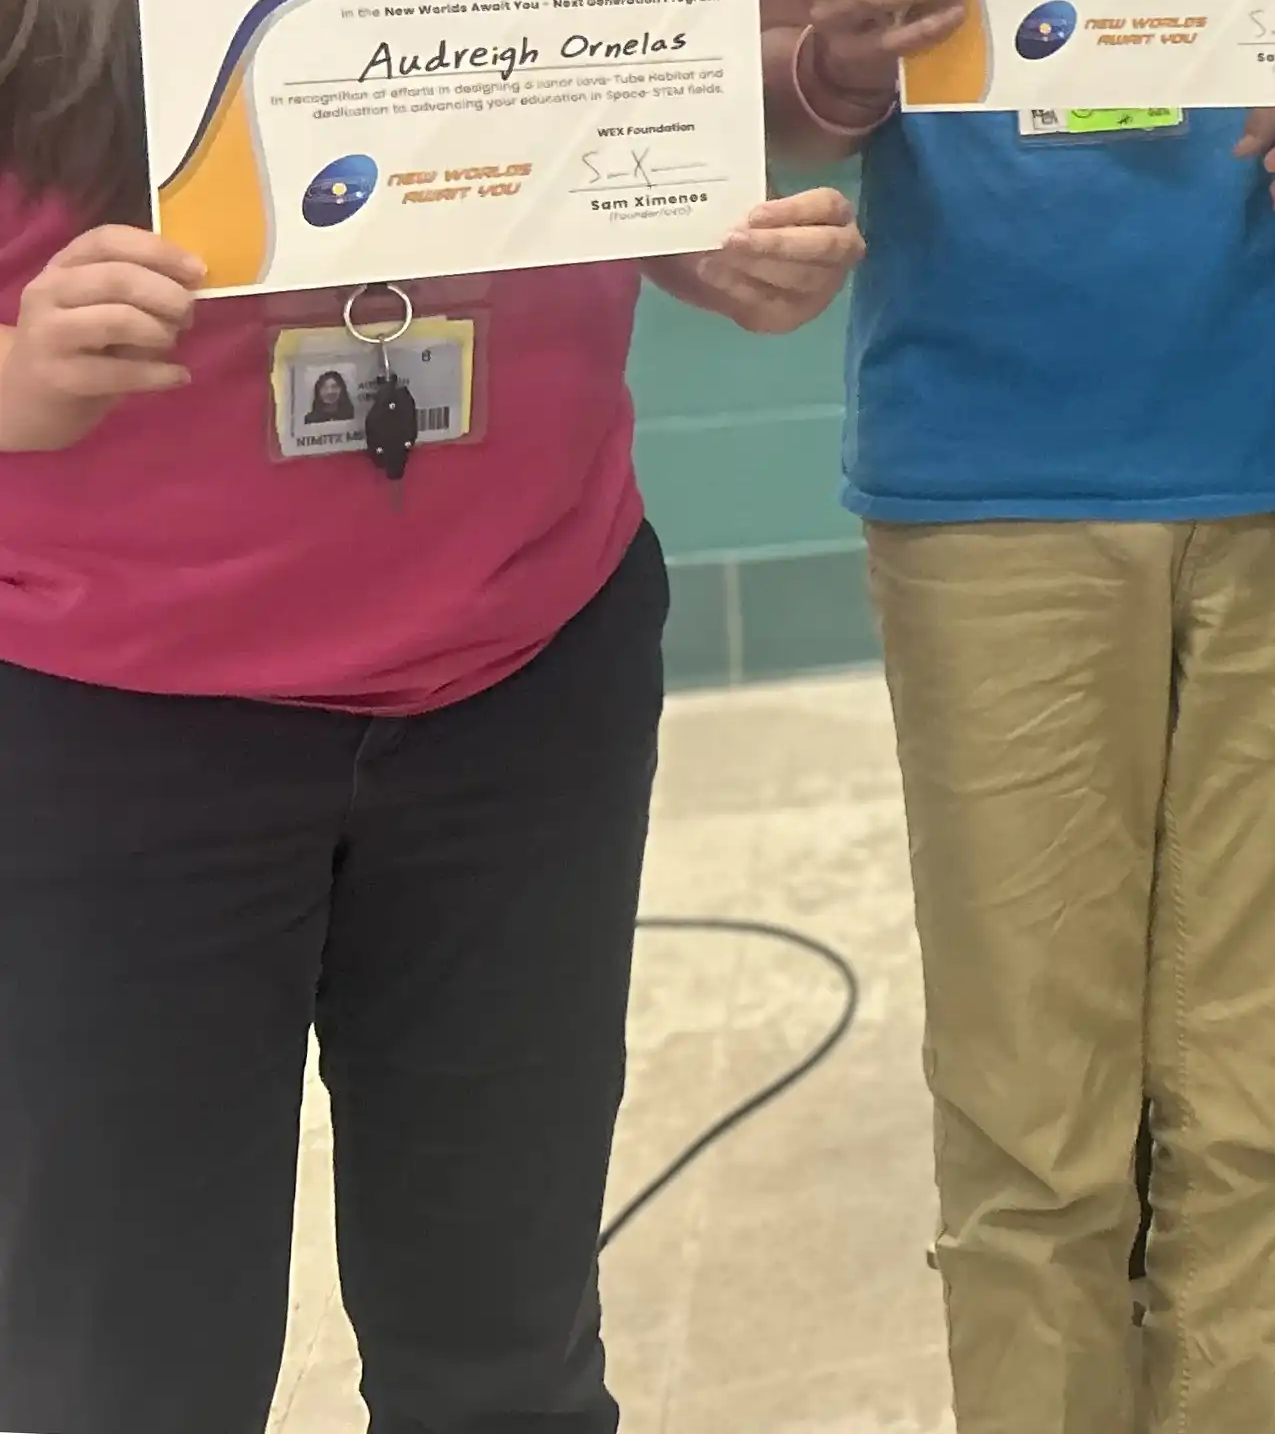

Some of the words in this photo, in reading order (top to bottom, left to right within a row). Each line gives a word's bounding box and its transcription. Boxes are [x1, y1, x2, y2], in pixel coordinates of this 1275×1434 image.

[385, 6, 415, 16] New
[418, 4, 467, 15] Worlds
[471, 0, 511, 12] Await
[514, 0, 540, 10] You
[1085, 18, 1126, 29] NEW
[1161, 33, 1198, 45] YOU
[358, 37, 539, 82] Audreigh
[560, 32, 687, 58] Ornelas
[288, 89, 369, 106] recognition
[455, 80, 520, 94] designing
[699, 68, 724, 79] and
[410, 98, 483, 114] advancing
[487, 96, 516, 109] your
[520, 93, 587, 106] education
[597, 126, 624, 137] WEX
[627, 123, 695, 135] Foundation
[387, 170, 438, 186] NEW
[444, 163, 533, 181] WORLDS
[478, 182, 522, 198] YOU
[591, 197, 628, 212] Sam
[634, 191, 708, 208] Ximenes
